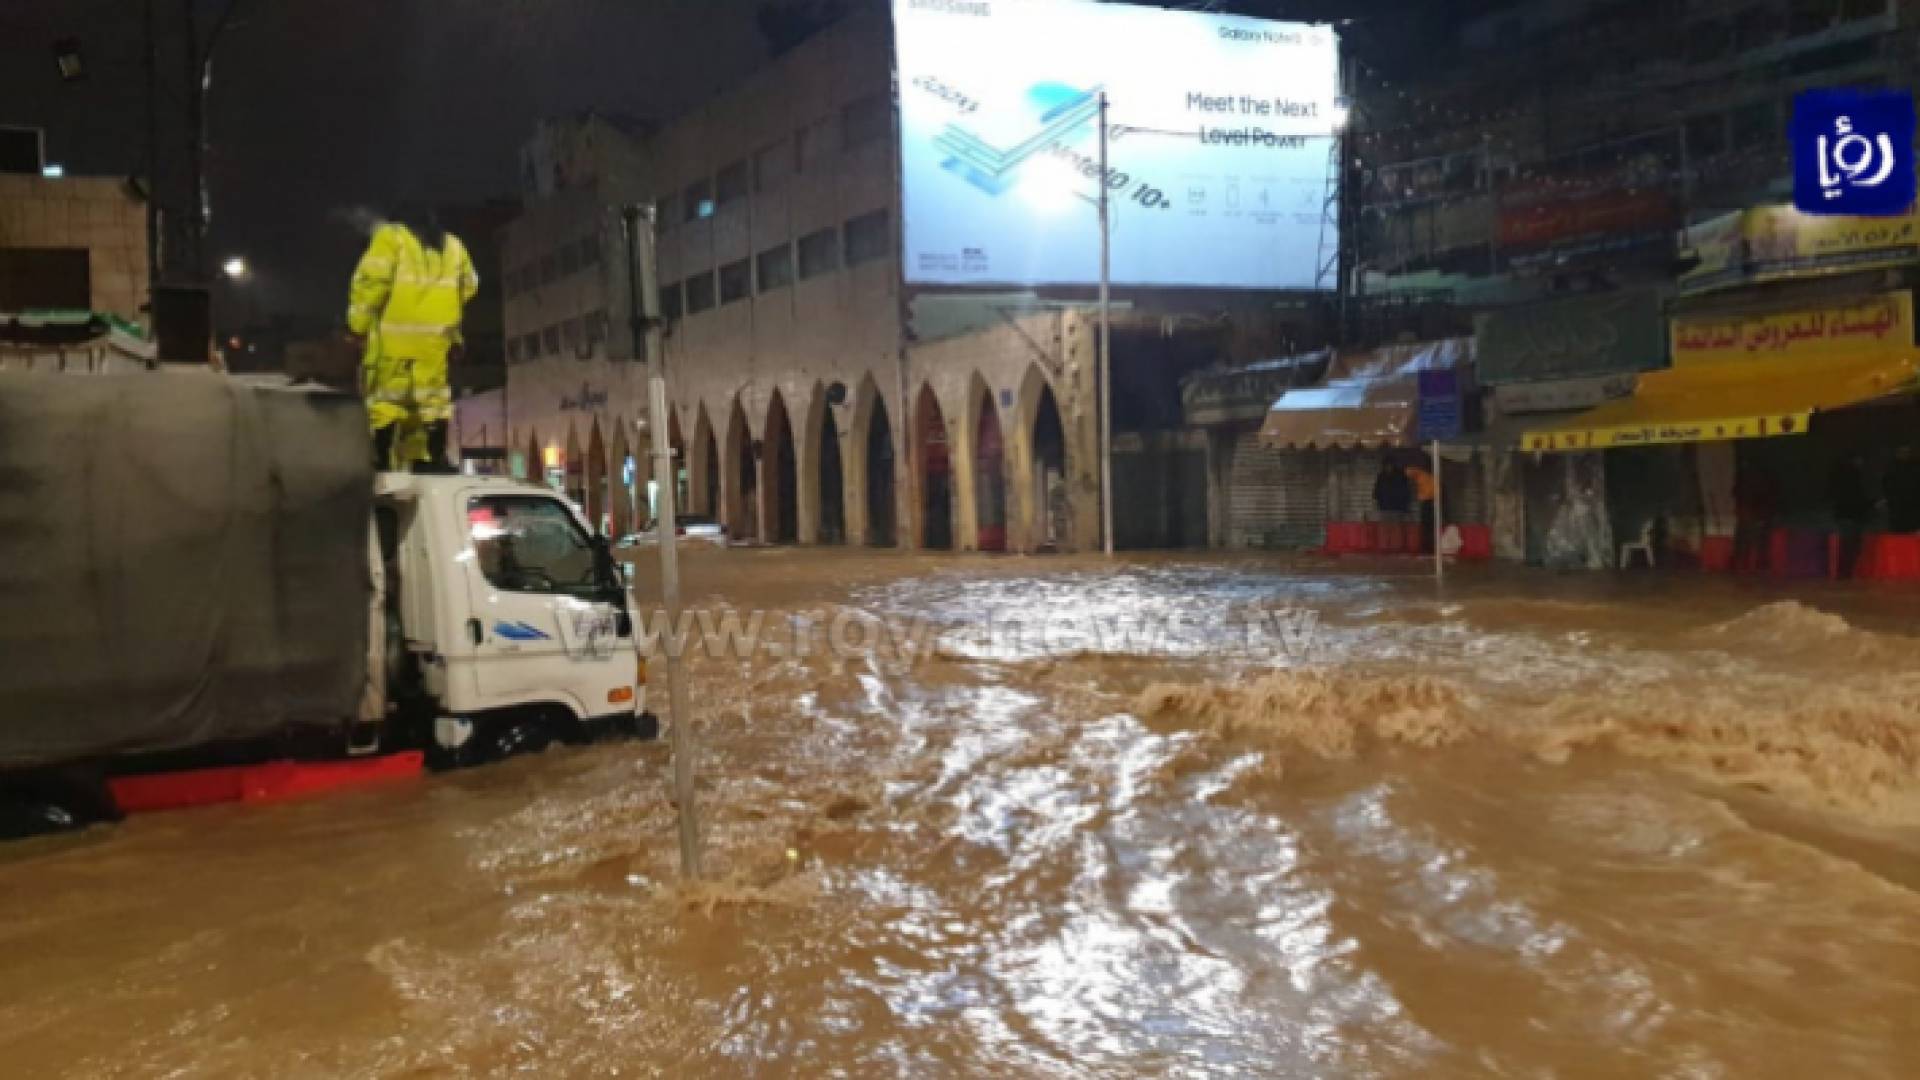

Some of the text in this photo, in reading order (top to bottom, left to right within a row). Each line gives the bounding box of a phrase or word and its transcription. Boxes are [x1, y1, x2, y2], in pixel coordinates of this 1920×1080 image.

[1186, 91, 1318, 118] Meet the Next
[1200, 125, 1305, 149] Level Power
